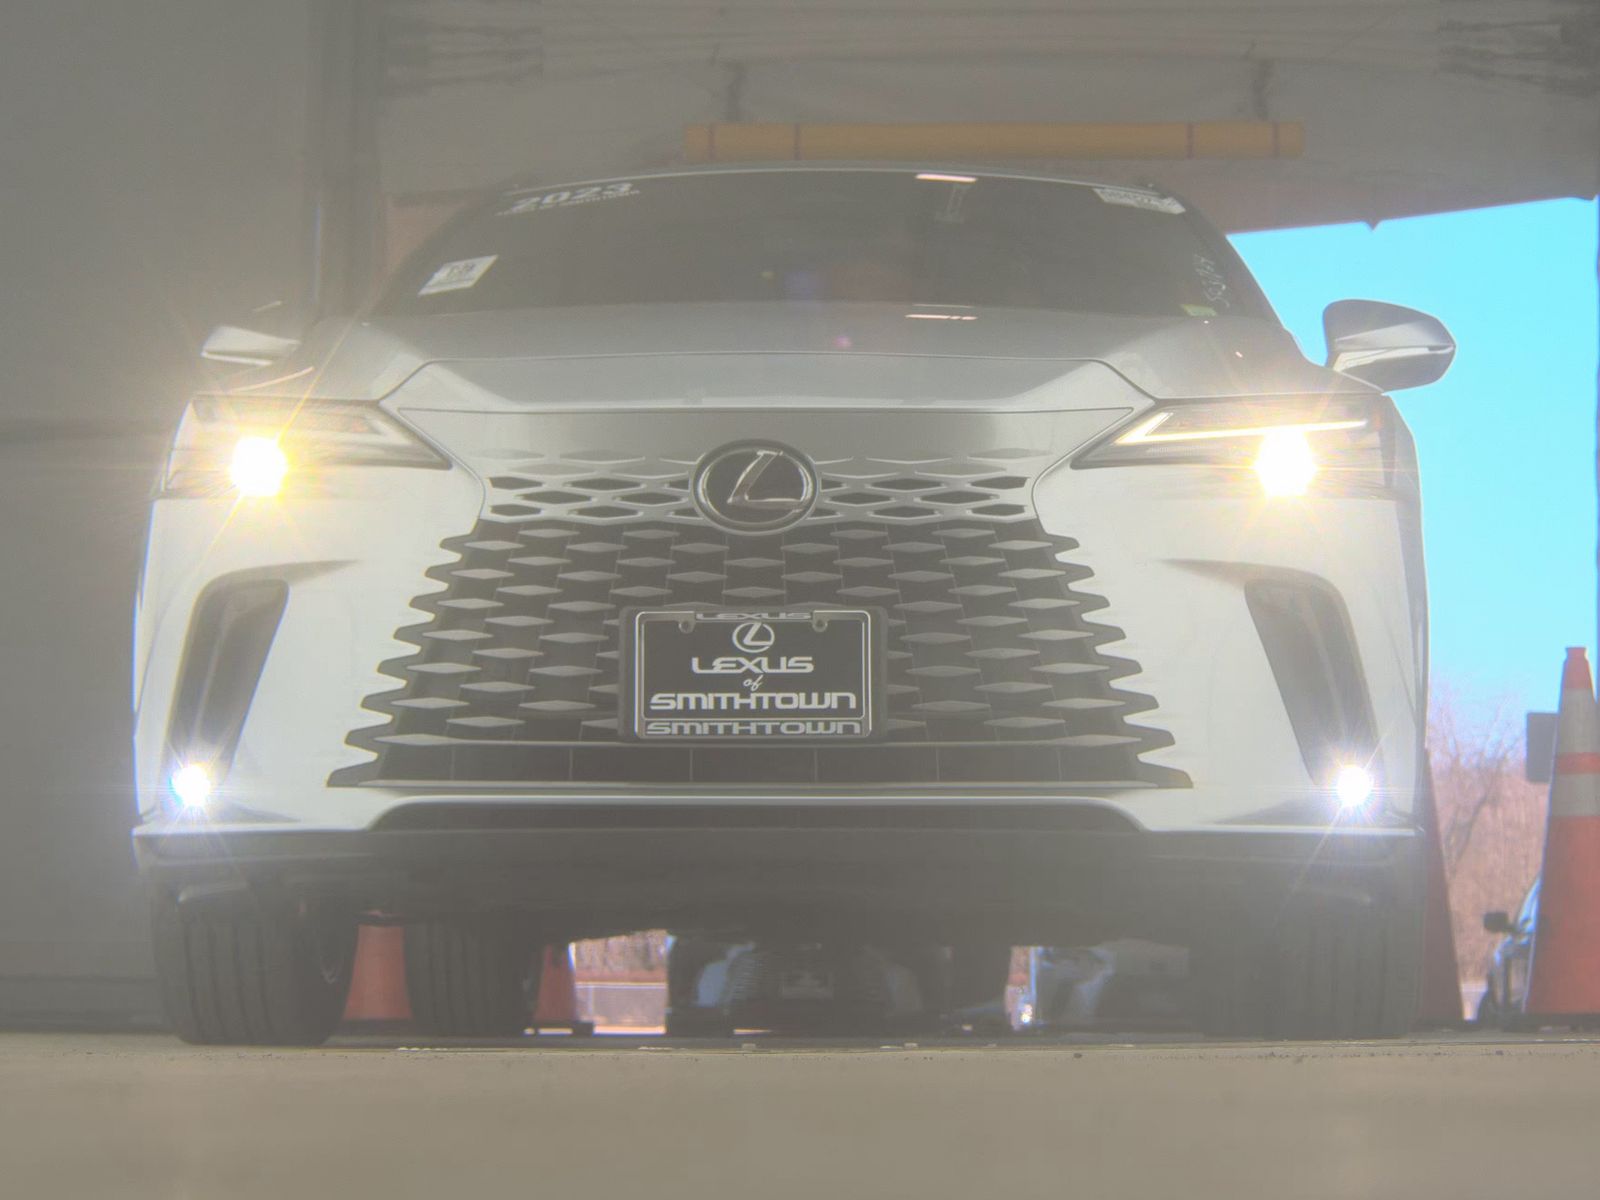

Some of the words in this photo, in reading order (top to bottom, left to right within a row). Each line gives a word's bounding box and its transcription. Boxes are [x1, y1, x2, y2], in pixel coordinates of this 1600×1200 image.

[510, 182, 634, 212] 2023
[695, 612, 812, 620] LEXUS
[691, 656, 814, 674] LEXUS
[743, 674, 764, 692] of
[650, 692, 857, 710] SMITHTOWN
[646, 721, 861, 735] SMITHTOWN
